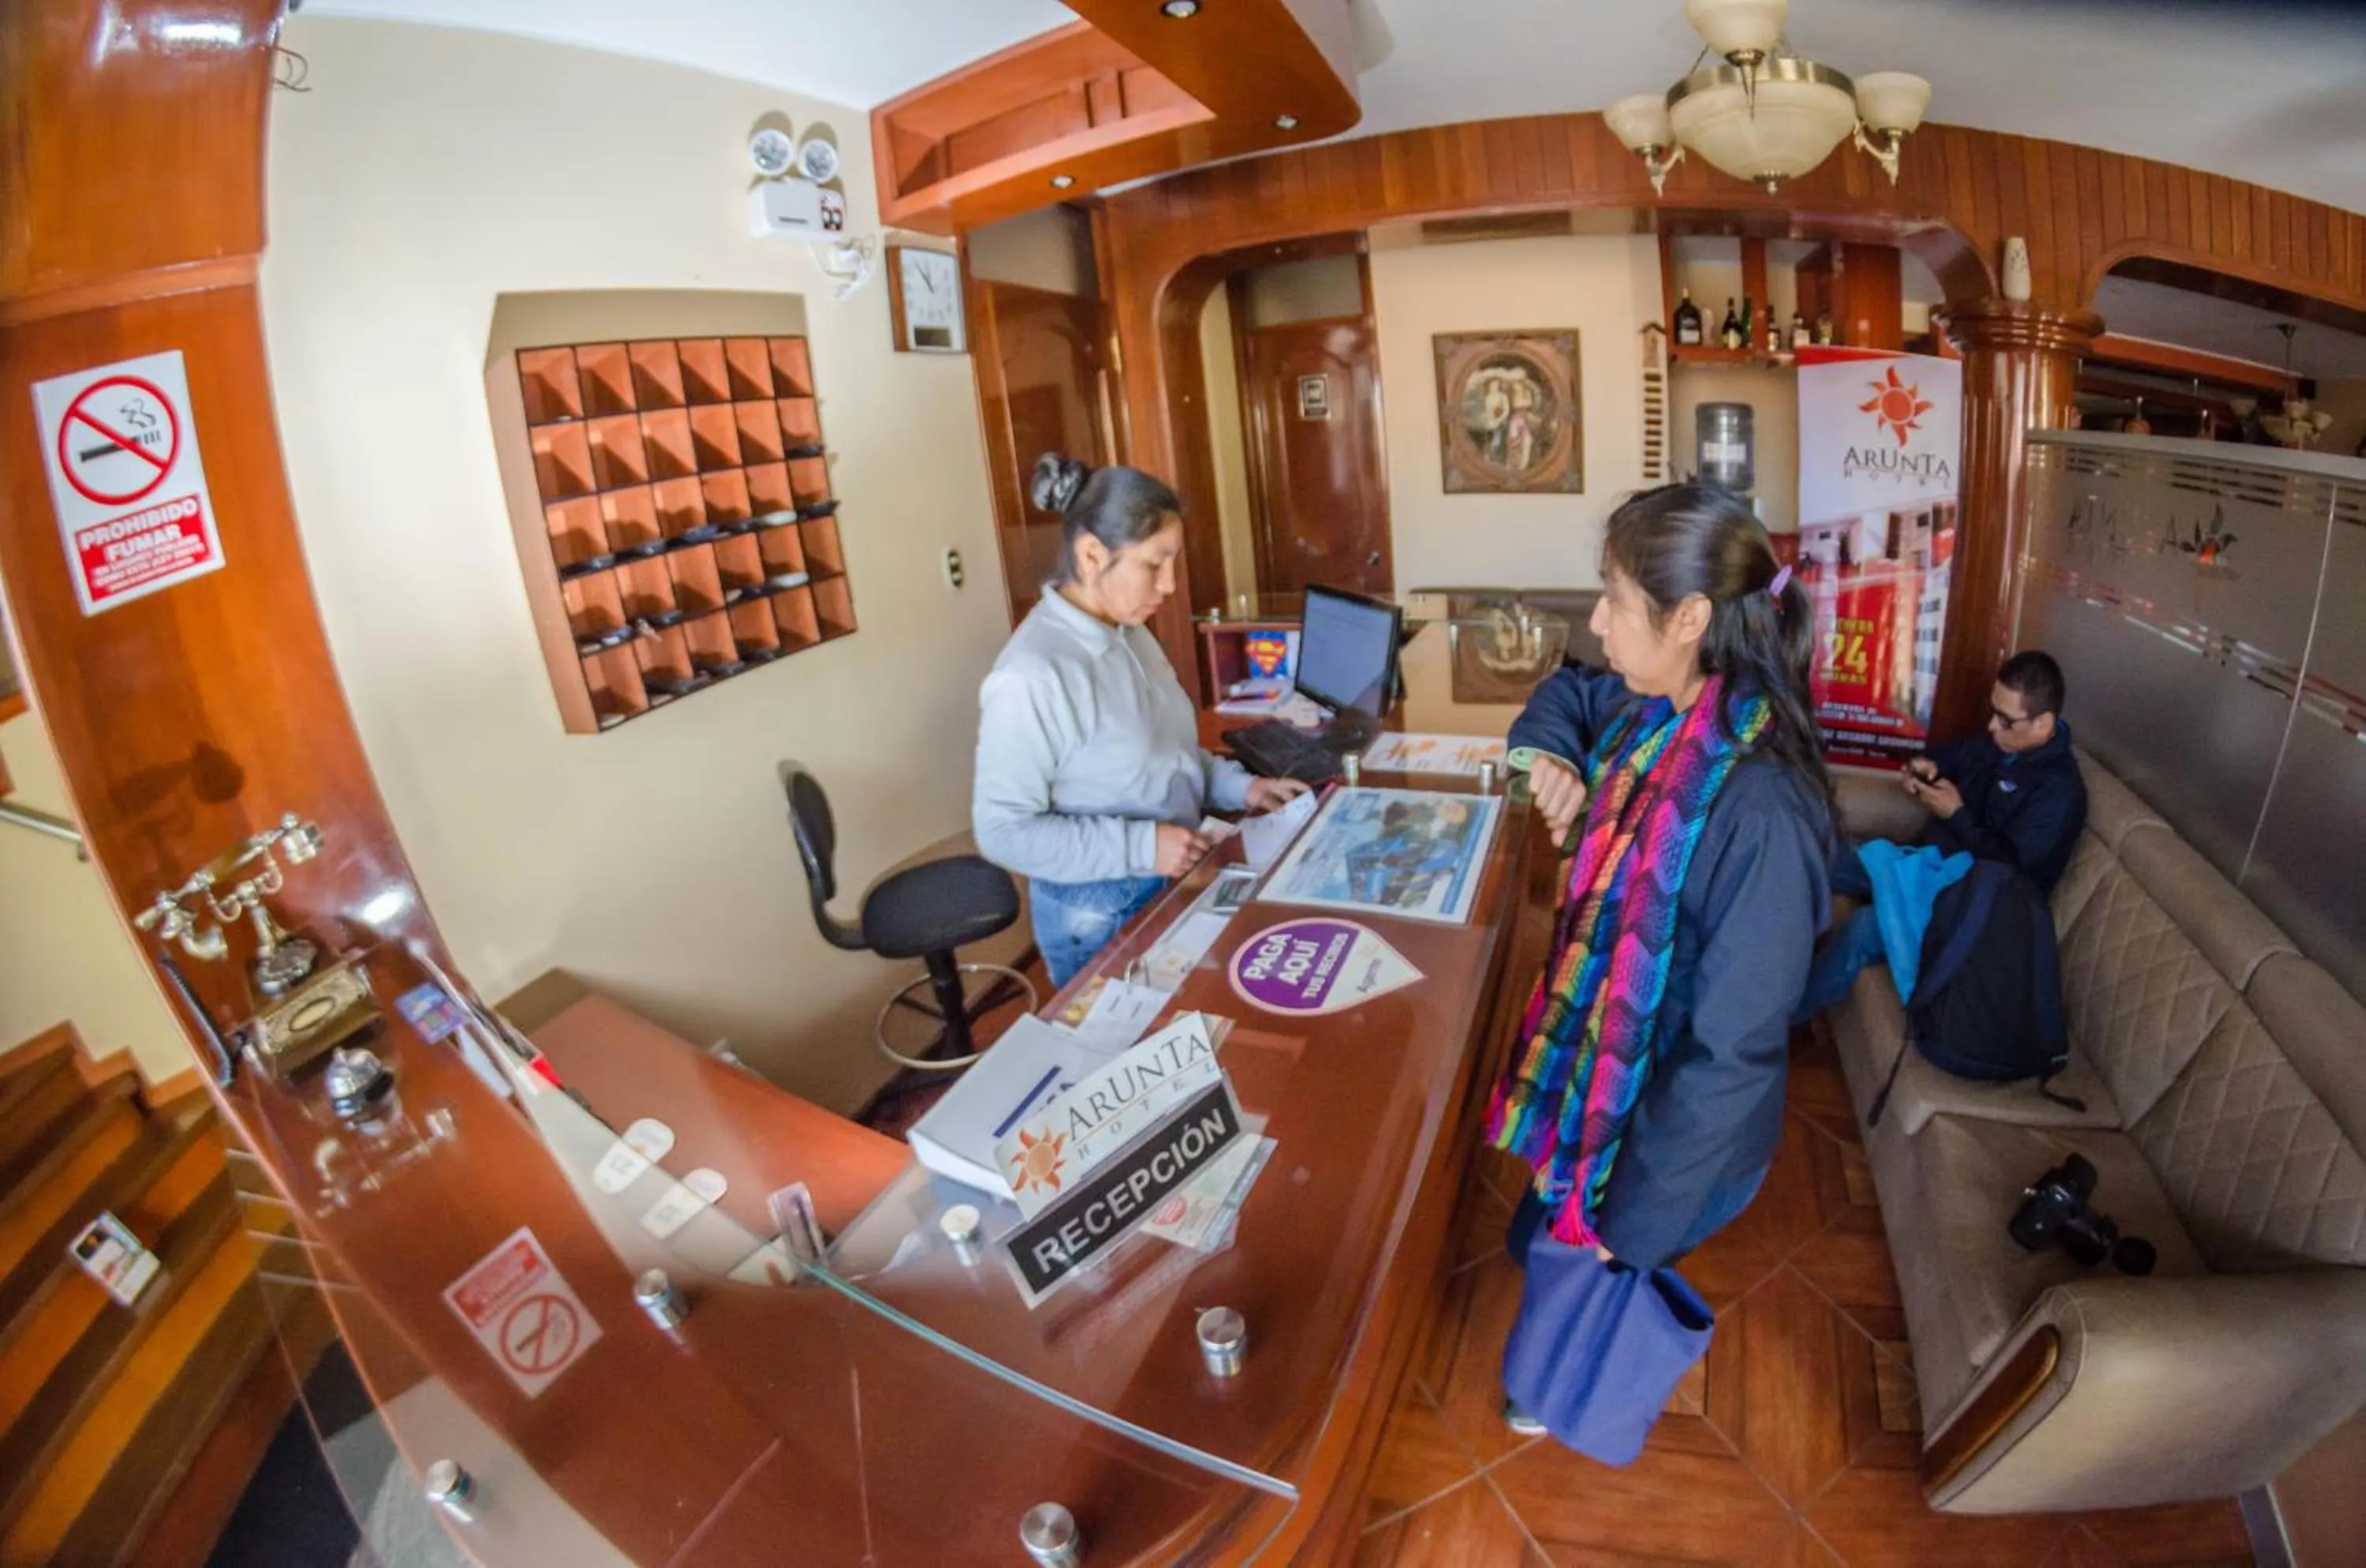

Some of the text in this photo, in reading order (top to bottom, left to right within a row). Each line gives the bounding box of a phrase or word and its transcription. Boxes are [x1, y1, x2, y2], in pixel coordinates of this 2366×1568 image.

[1843, 446, 1950, 477] ARUNTA
[80, 497, 199, 551] PROHIBIDO
[103, 523, 182, 562] FUMAR
[1822, 633, 1868, 674] 24
[1243, 933, 1293, 980] PAGA
[1278, 939, 1320, 985] AQUÍ
[1302, 976, 1326, 998] TUS
[1069, 1033, 1210, 1141] ARUNTA
[1077, 1064, 1216, 1161] HOTEL
[1032, 1107, 1227, 1274] RECEPCIÓN
